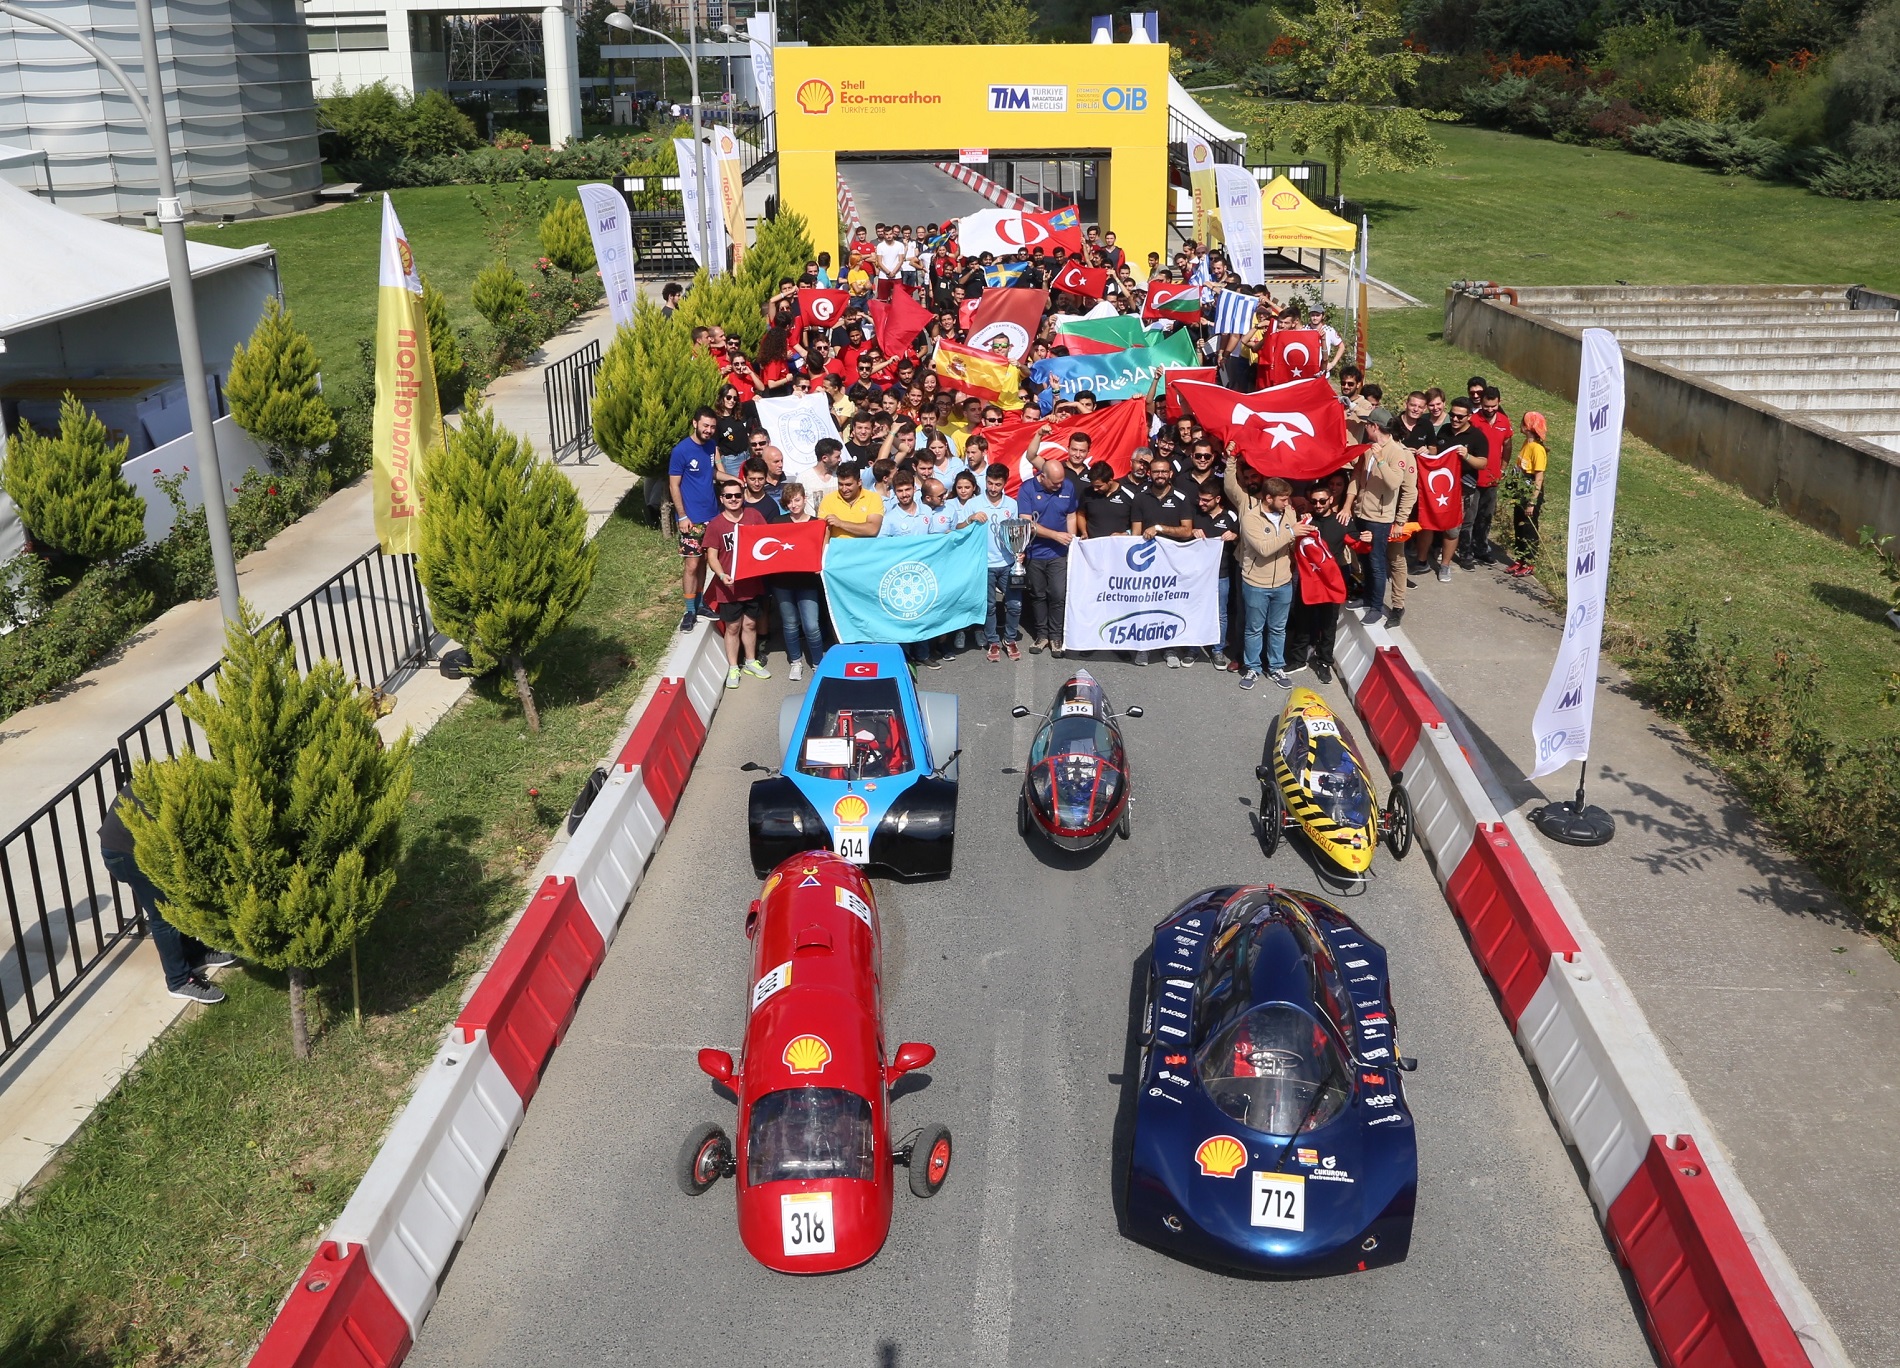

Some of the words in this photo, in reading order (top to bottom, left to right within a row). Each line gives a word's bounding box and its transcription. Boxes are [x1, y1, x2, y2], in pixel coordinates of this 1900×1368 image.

[841, 80, 865, 90] Shell
[840, 91, 942, 104] Eco-marathon
[841, 105, 869, 114] TÜRKİYE
[870, 106, 886, 114] 2018
[1108, 575, 1178, 591] ÇUKUROVA
[1067, 705, 1088, 713] 316
[1311, 721, 1335, 732] 320
[840, 838, 863, 858] 614
[848, 895, 868, 920] 318
[757, 972, 778, 1001] 318
[1261, 1188, 1296, 1220] 712
[791, 1211, 825, 1245] 318
